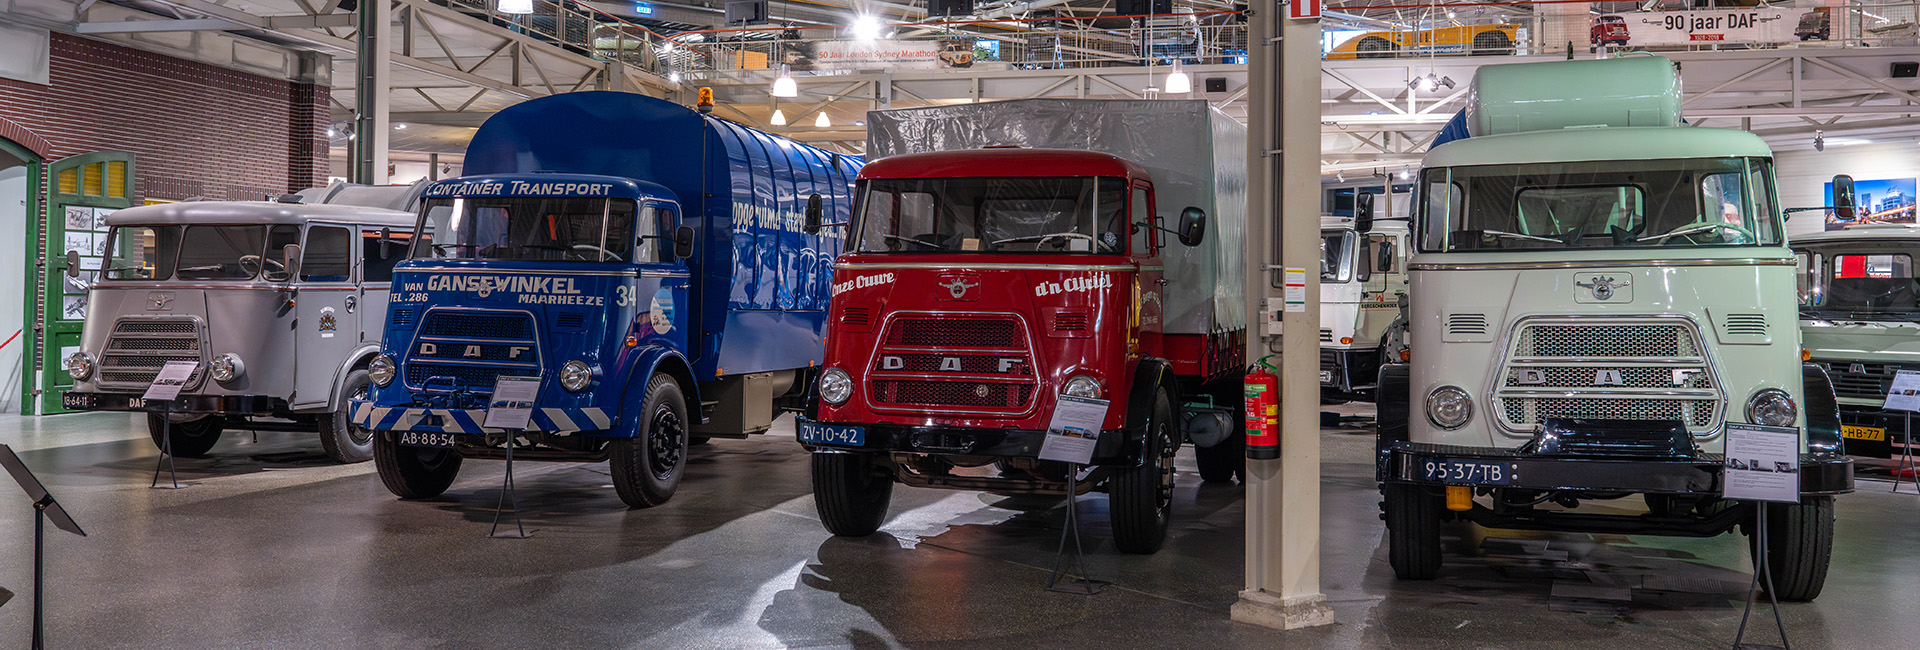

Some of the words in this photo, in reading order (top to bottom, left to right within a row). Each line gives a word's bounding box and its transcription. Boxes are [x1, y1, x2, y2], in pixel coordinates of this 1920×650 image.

[1665, 15, 1684, 30] 90
[1689, 14, 1723, 33] jaar
[1727, 13, 1758, 29] DAF
[819, 51, 829, 59] 50
[830, 51, 845, 59] Jaar
[846, 50, 872, 58] London
[874, 50, 900, 60] Sydney
[901, 50, 936, 58] Marathon
[426, 181, 503, 196] CONTAINER
[510, 180, 613, 196] TRANSPORT
[404, 283, 424, 291] VAN
[427, 274, 581, 294] GANSEWINKEL
[856, 272, 895, 289] Ouwe
[518, 293, 604, 307] MAARHEEZE
[616, 284, 637, 307] 34
[420, 343, 530, 360] DAF
[883, 356, 1023, 373] DAF
[1518, 368, 1702, 387] DAF
[129, 398, 148, 408] DAF
[401, 432, 456, 446] AB-88-54
[803, 425, 858, 444] ZV-10-42
[1425, 462, 1502, 481] 95-37-TB
